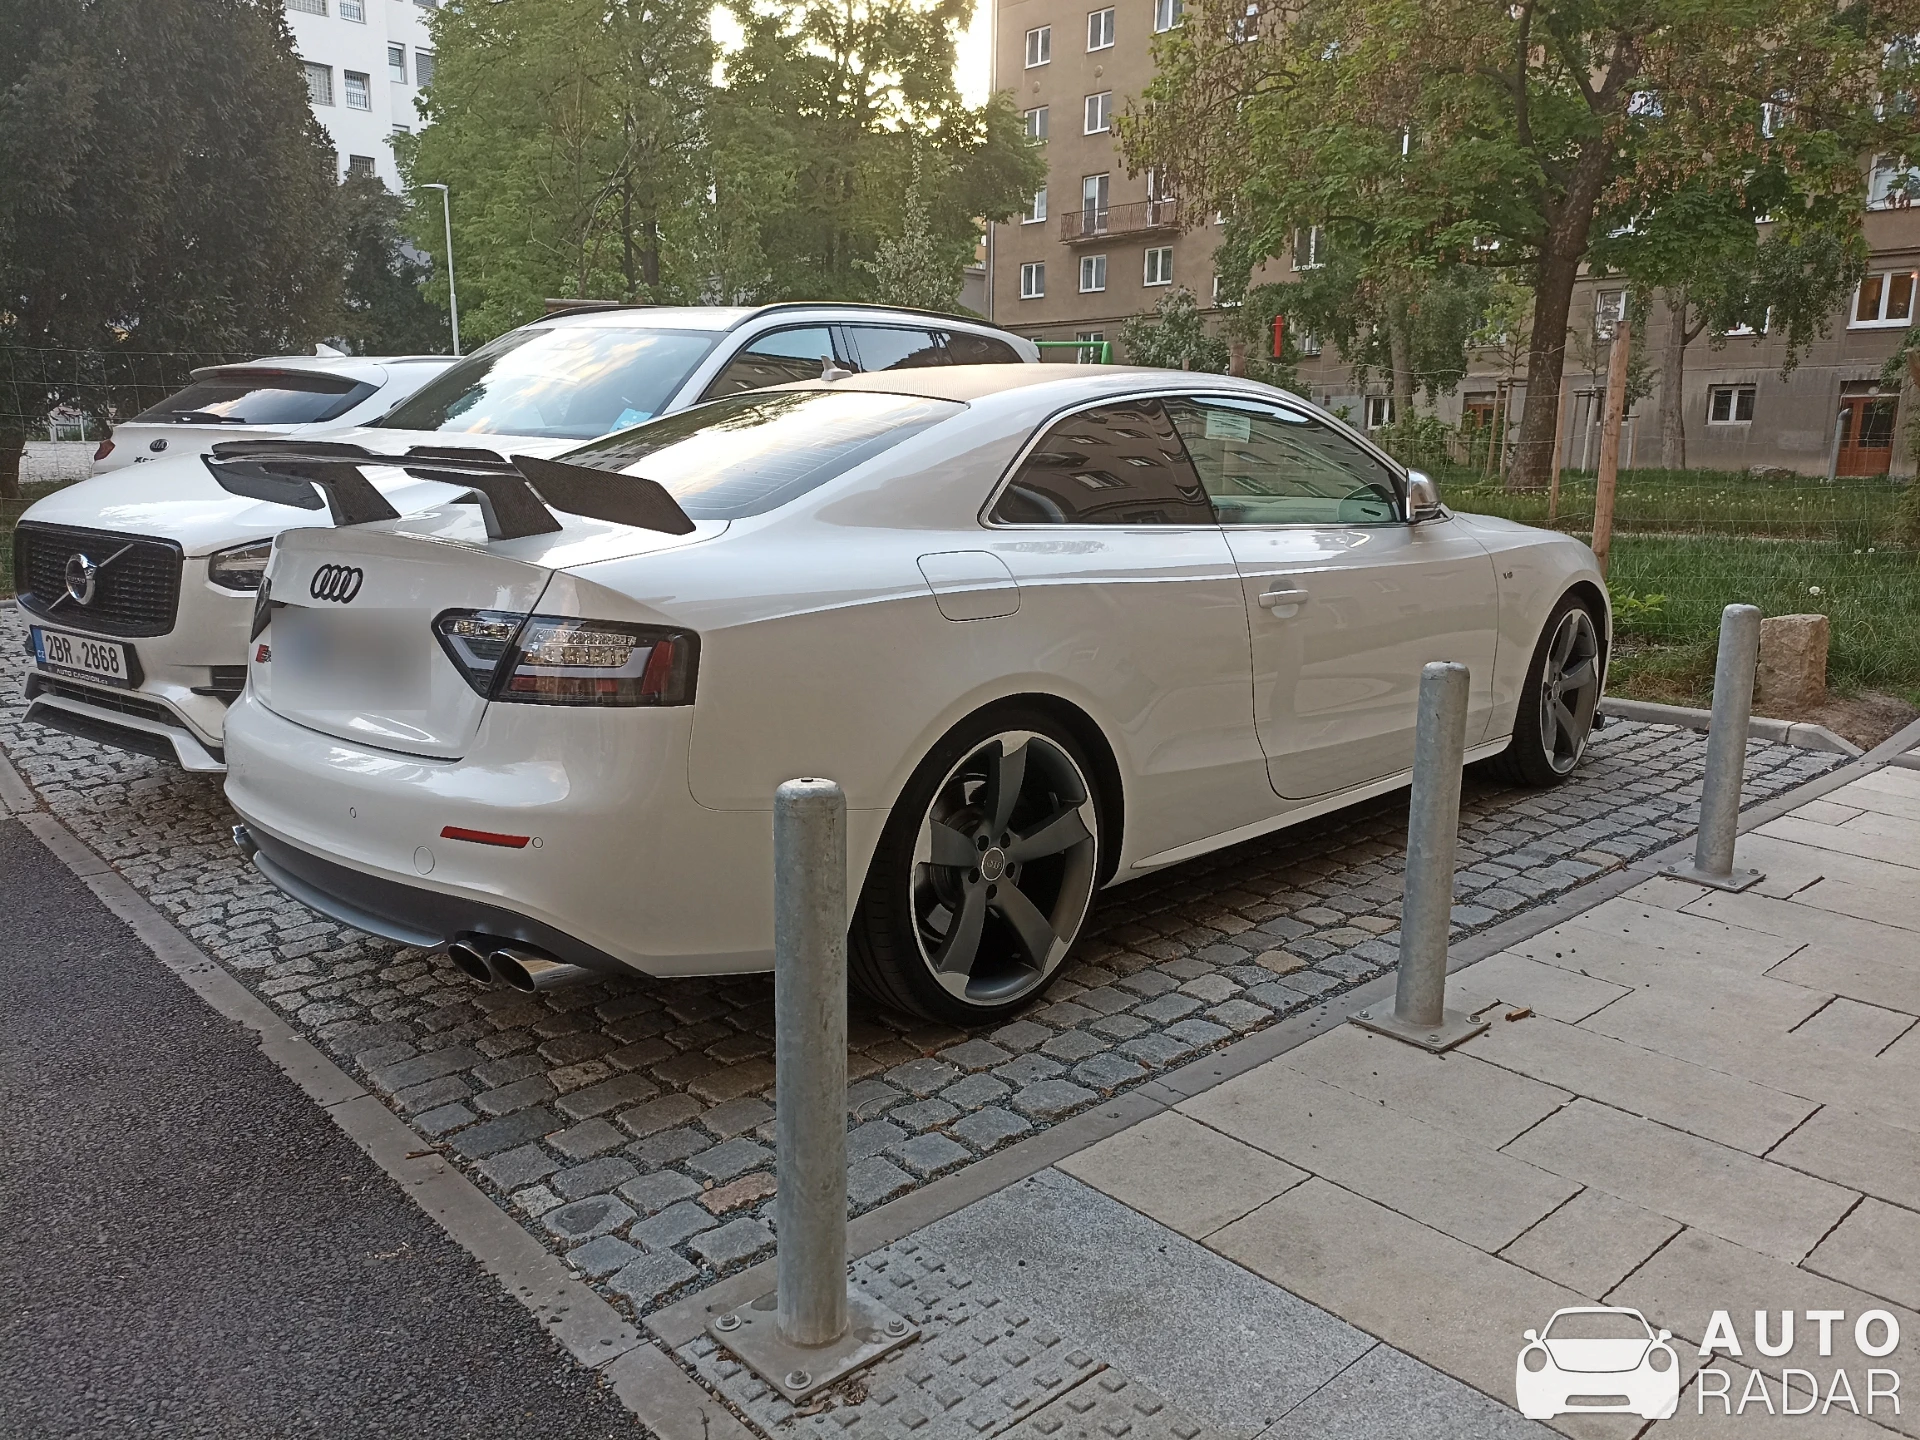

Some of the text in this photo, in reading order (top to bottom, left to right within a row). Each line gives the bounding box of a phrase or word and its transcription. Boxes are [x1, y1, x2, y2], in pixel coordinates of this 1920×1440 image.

[150, 440, 168, 450] KIA
[37, 650, 45, 658] CZ
[46, 634, 119, 673] 2BR 2868
